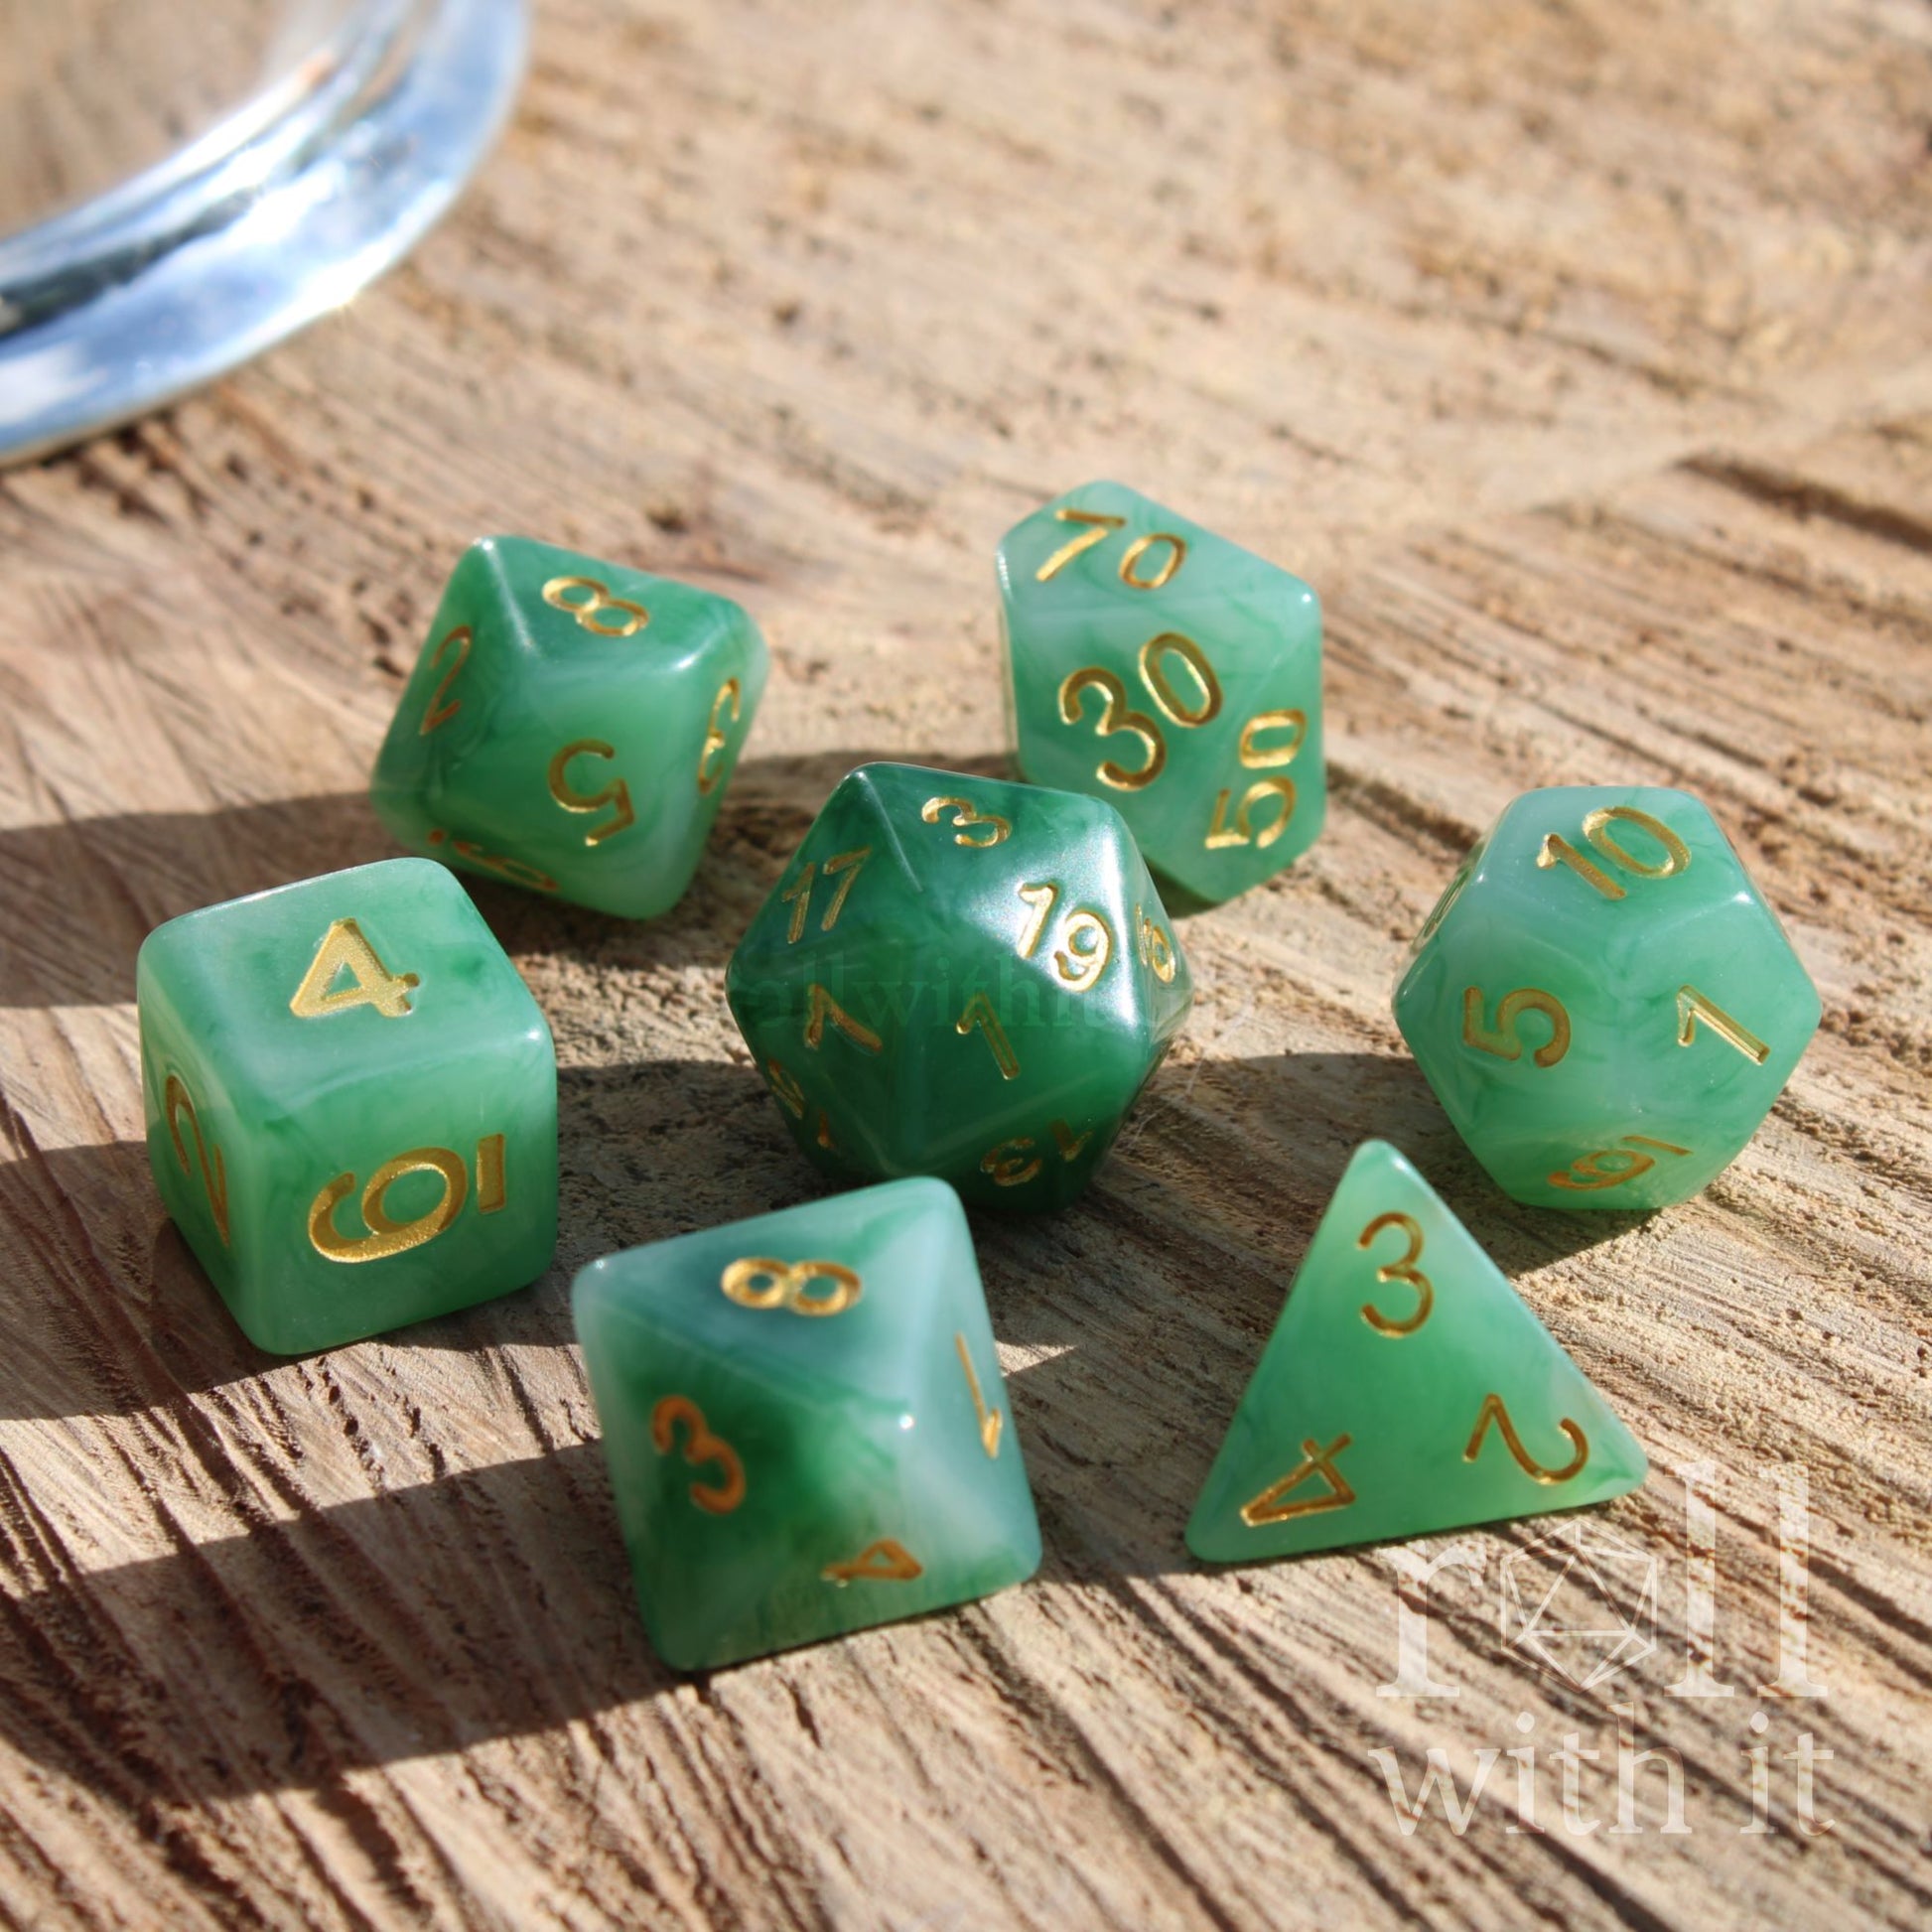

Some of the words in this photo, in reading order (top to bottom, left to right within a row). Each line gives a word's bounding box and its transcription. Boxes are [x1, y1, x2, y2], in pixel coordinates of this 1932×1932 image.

[1035, 508, 1187, 590] 70
[541, 576, 648, 636] 8
[420, 624, 471, 736] 2
[1058, 631, 1223, 791] 30
[547, 739, 634, 846] 5
[921, 796, 1012, 848] 3
[1204, 708, 1308, 849] 50
[782, 847, 872, 944] 17
[1536, 805, 1692, 900] 10
[289, 917, 420, 1019] 4
[1018, 882, 1114, 992] 19
[1462, 986, 1572, 1068] 5
[165, 1074, 230, 1248] 2
[720, 1256, 863, 1317] 8
[1355, 1211, 1435, 1339] 3
[651, 1395, 747, 1515] 3
[1240, 1433, 1356, 1527] 4
[1462, 1393, 1589, 1485] 2
[821, 1538, 922, 1587] 4
